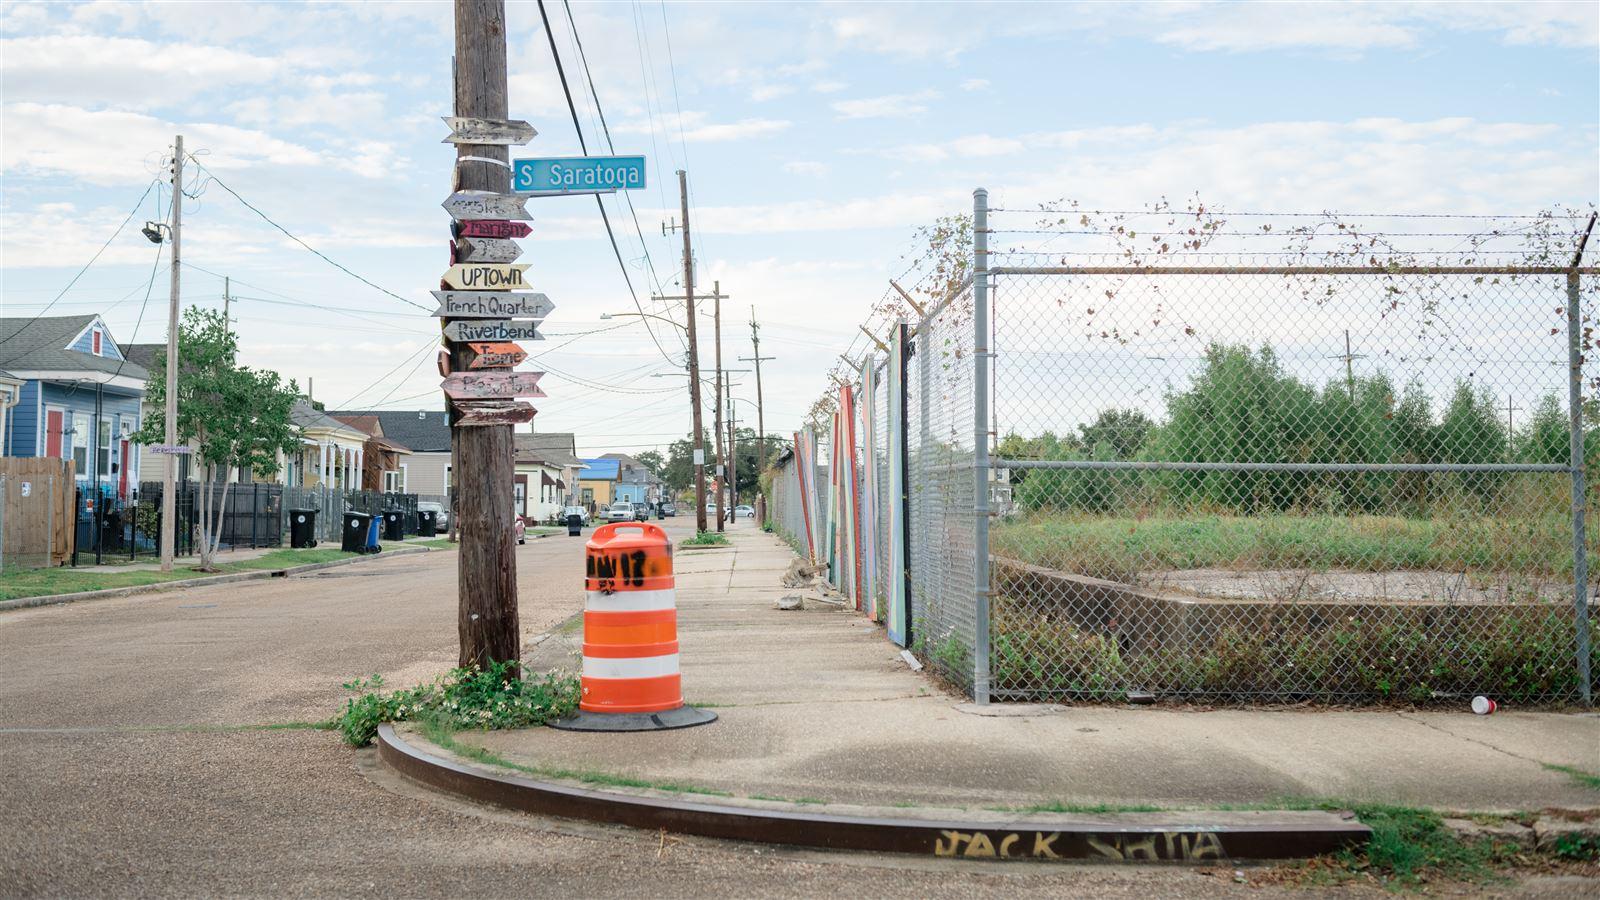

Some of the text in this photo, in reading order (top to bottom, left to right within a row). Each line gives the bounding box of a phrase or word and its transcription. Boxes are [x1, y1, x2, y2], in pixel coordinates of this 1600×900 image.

[520, 163, 639, 189] S Saratoga
[446, 295, 542, 315] French Quarter
[458, 322, 535, 340] Riverbend
[934, 829, 1061, 860] JACK
